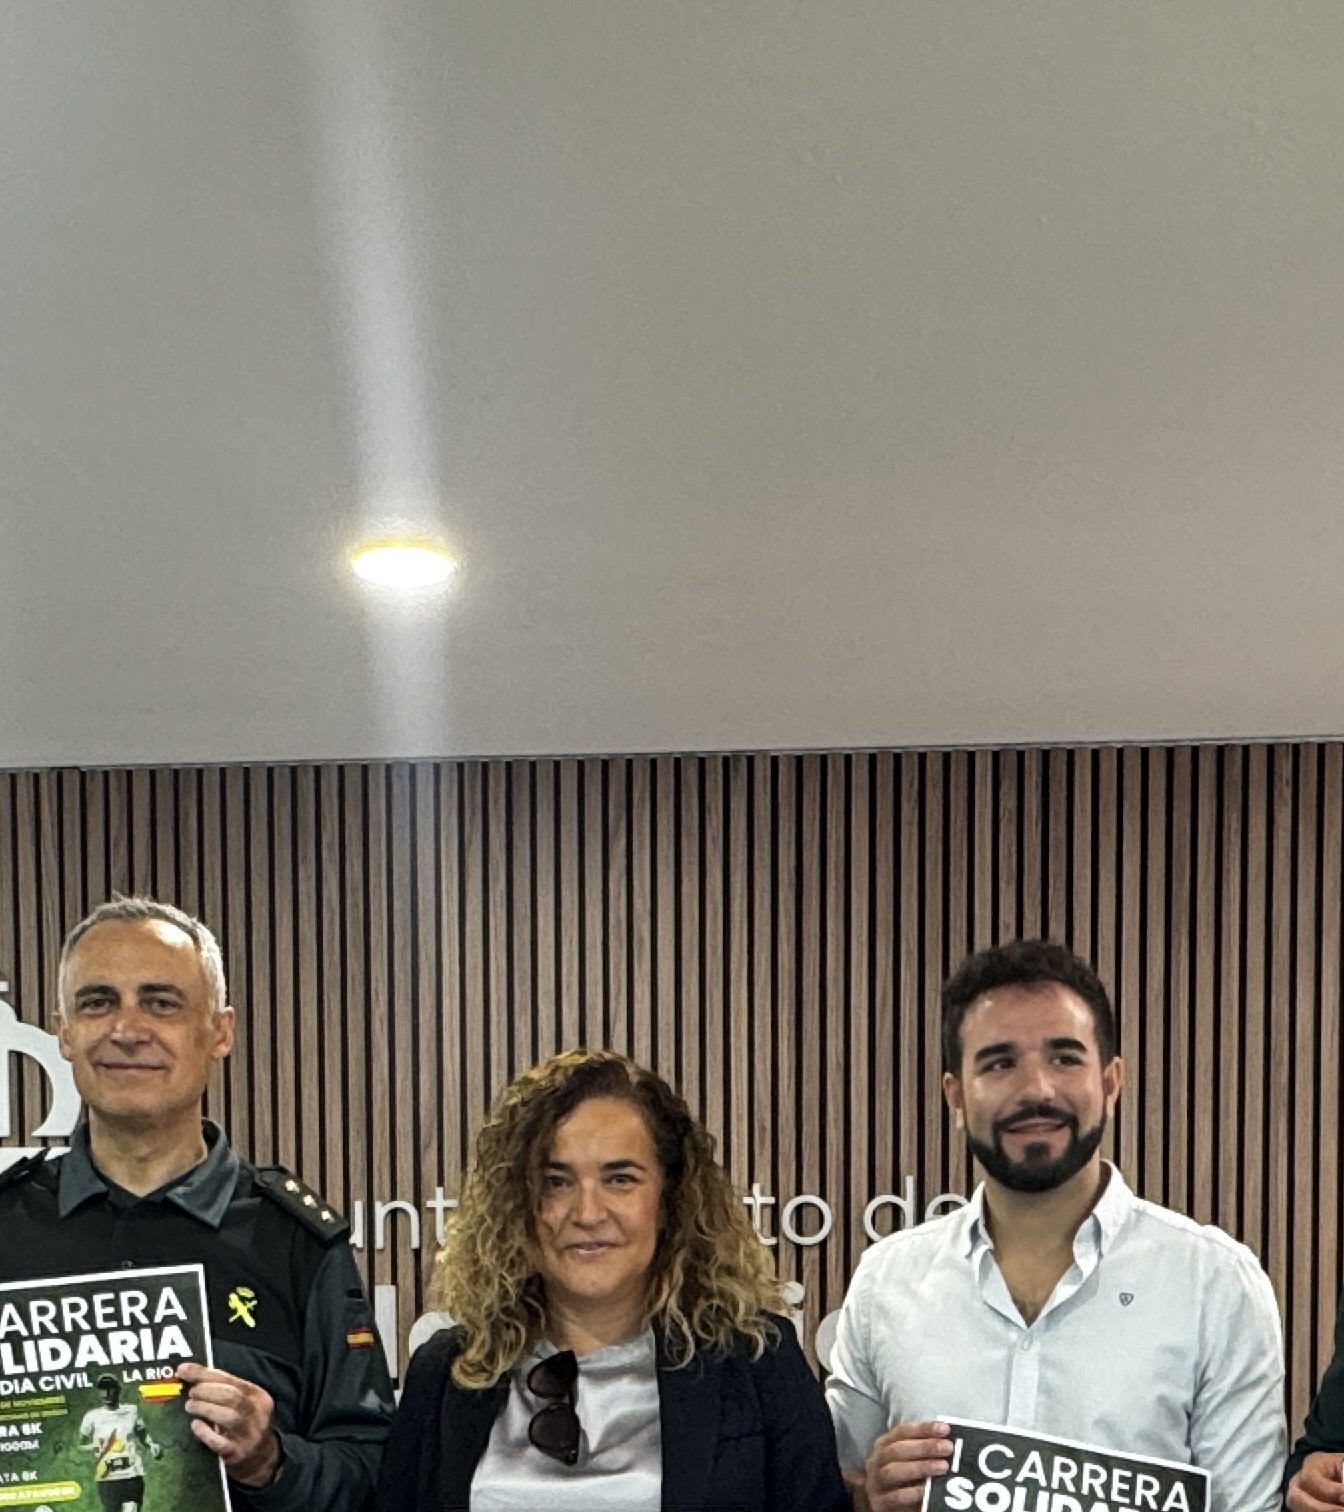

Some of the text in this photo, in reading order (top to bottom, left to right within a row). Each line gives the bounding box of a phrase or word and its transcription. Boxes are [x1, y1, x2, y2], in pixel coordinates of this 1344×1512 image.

[38, 1371, 94, 1391] CIVIL
[122, 1369, 143, 1384] LA
[145, 1366, 178, 1380] RIO
[951, 1438, 964, 1474] I
